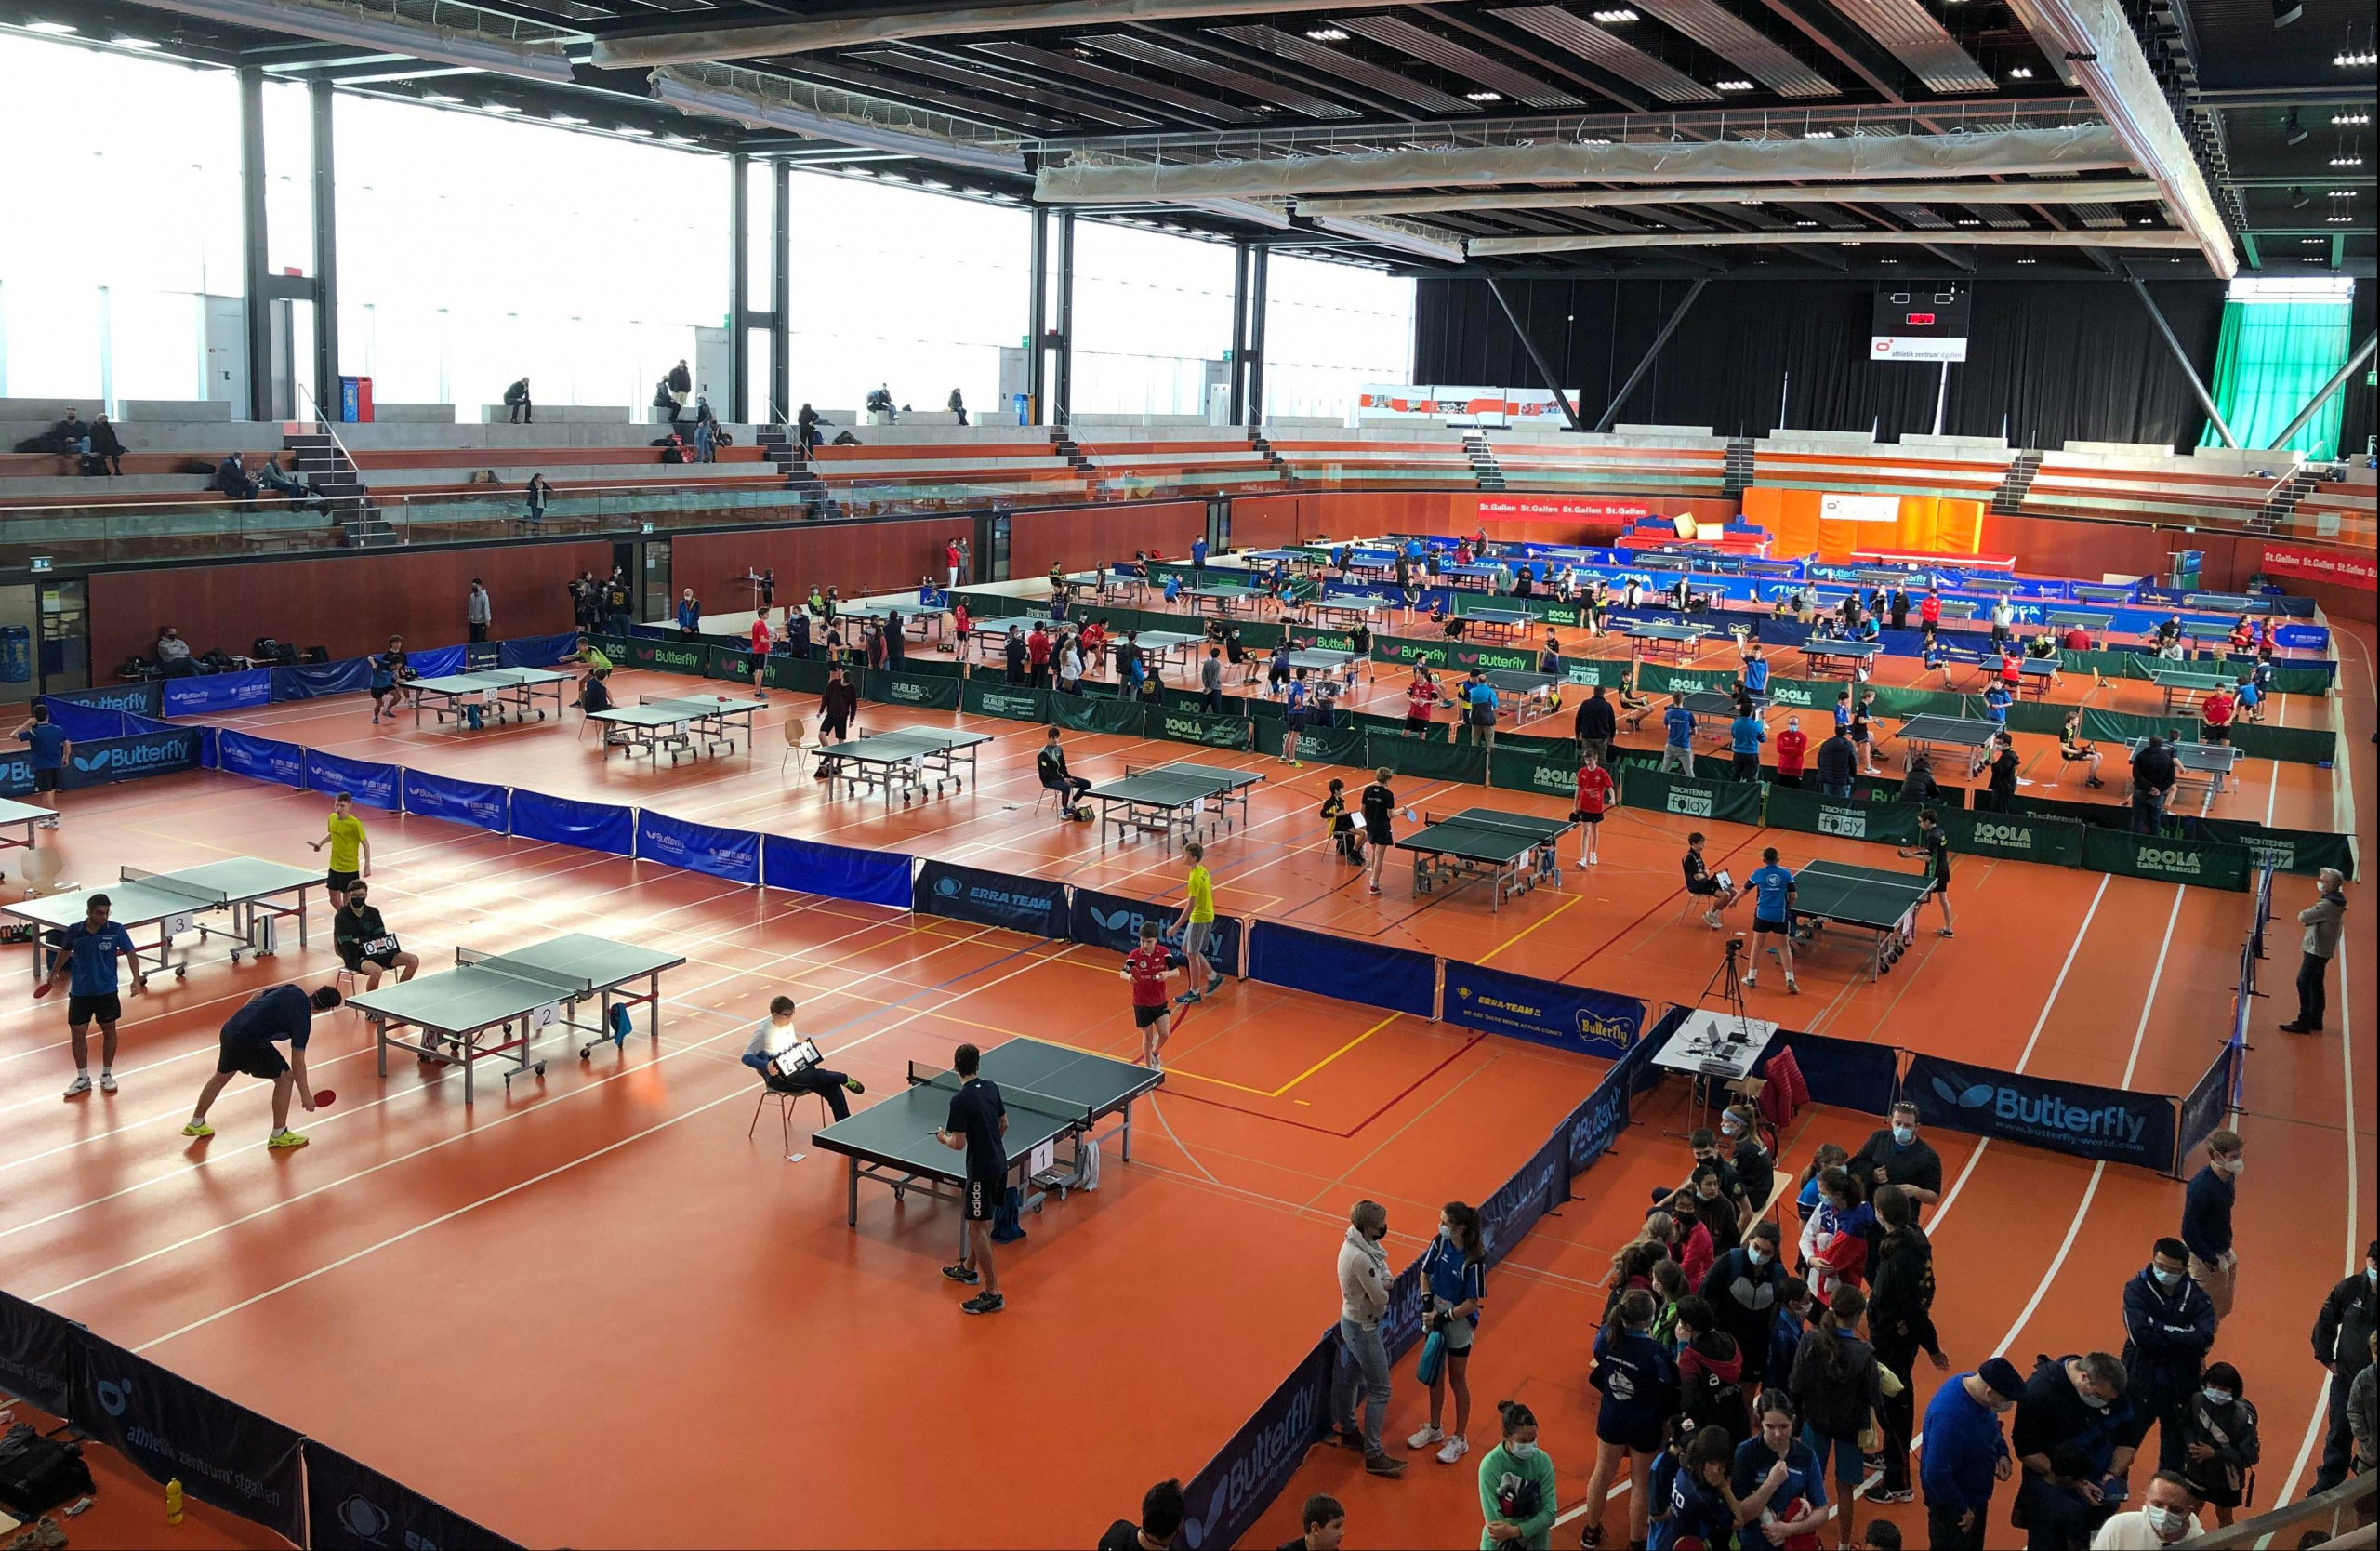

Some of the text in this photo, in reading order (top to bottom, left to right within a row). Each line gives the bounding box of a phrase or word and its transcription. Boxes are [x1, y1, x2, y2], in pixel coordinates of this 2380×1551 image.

[1479, 503, 1646, 516] St.Gallen St.Gallen St.Gallen St.Gallen
[2265, 552, 2300, 565] St.Gallen
[2303, 557, 2335, 570] St.Gallen
[2337, 562, 2366, 576] St.Gallen
[1612, 572, 1652, 583] STIGA
[1548, 610, 1575, 619] JOOLA
[655, 649, 697, 667] Butterfly
[1479, 654, 1526, 670] Butterfly
[737, 661, 776, 680] Bufly
[892, 682, 920, 694] GUBLER
[1669, 678, 1704, 690] JOOLA
[486, 690, 496, 699] 10
[983, 697, 1005, 706] GUBLER
[1774, 688, 1811, 701] JOOLA
[1179, 700, 1214, 714] JOOA
[680, 723, 685, 732] 9
[1165, 718, 1203, 734] JOOLA
[1283, 733, 1317, 747] GBLER
[111, 740, 188, 767] Butterfly
[916, 758, 920, 767] 8
[1534, 766, 1577, 785] JOOLA
[1554, 781, 1578, 790] tenni
[1670, 785, 1712, 798] TISCHTENNIS
[1197, 801, 1201, 811] 7
[1821, 805, 1866, 817] TISCHTENNIS
[1975, 823, 2031, 842] JOOLA
[1974, 836, 2031, 849] table tennis
[2239, 837, 2294, 849] TISCHTENNIS
[2138, 847, 2200, 867] JOOLA
[2137, 861, 2200, 874] table tennis
[970, 886, 1010, 903] ERRA
[1012, 894, 1053, 910] TEAM
[175, 918, 185, 932] 3
[1130, 912, 1223, 956] Bttey
[366, 943, 375, 953] 0
[386, 937, 394, 948] 0
[1478, 995, 1533, 1015] ERRA-TEAM
[542, 1009, 551, 1025] 2
[1485, 1014, 1502, 1023] THERE
[1502, 1018, 1518, 1027] WHEN
[1518, 1022, 1540, 1032] ACTION
[1541, 1027, 1562, 1037] COMES
[1582, 1018, 1627, 1043] Butterfly
[783, 1047, 815, 1073] 2 1
[1996, 1087, 2145, 1143] Butterfly
[1995, 1120, 2145, 1152] www.butterfly-world.com
[1039, 1149, 1045, 1168] 1
[1230, 1383, 1314, 1510] Butterfly
[126, 1425, 176, 1458] athletik
[235, 1472, 279, 1507] stgallen
